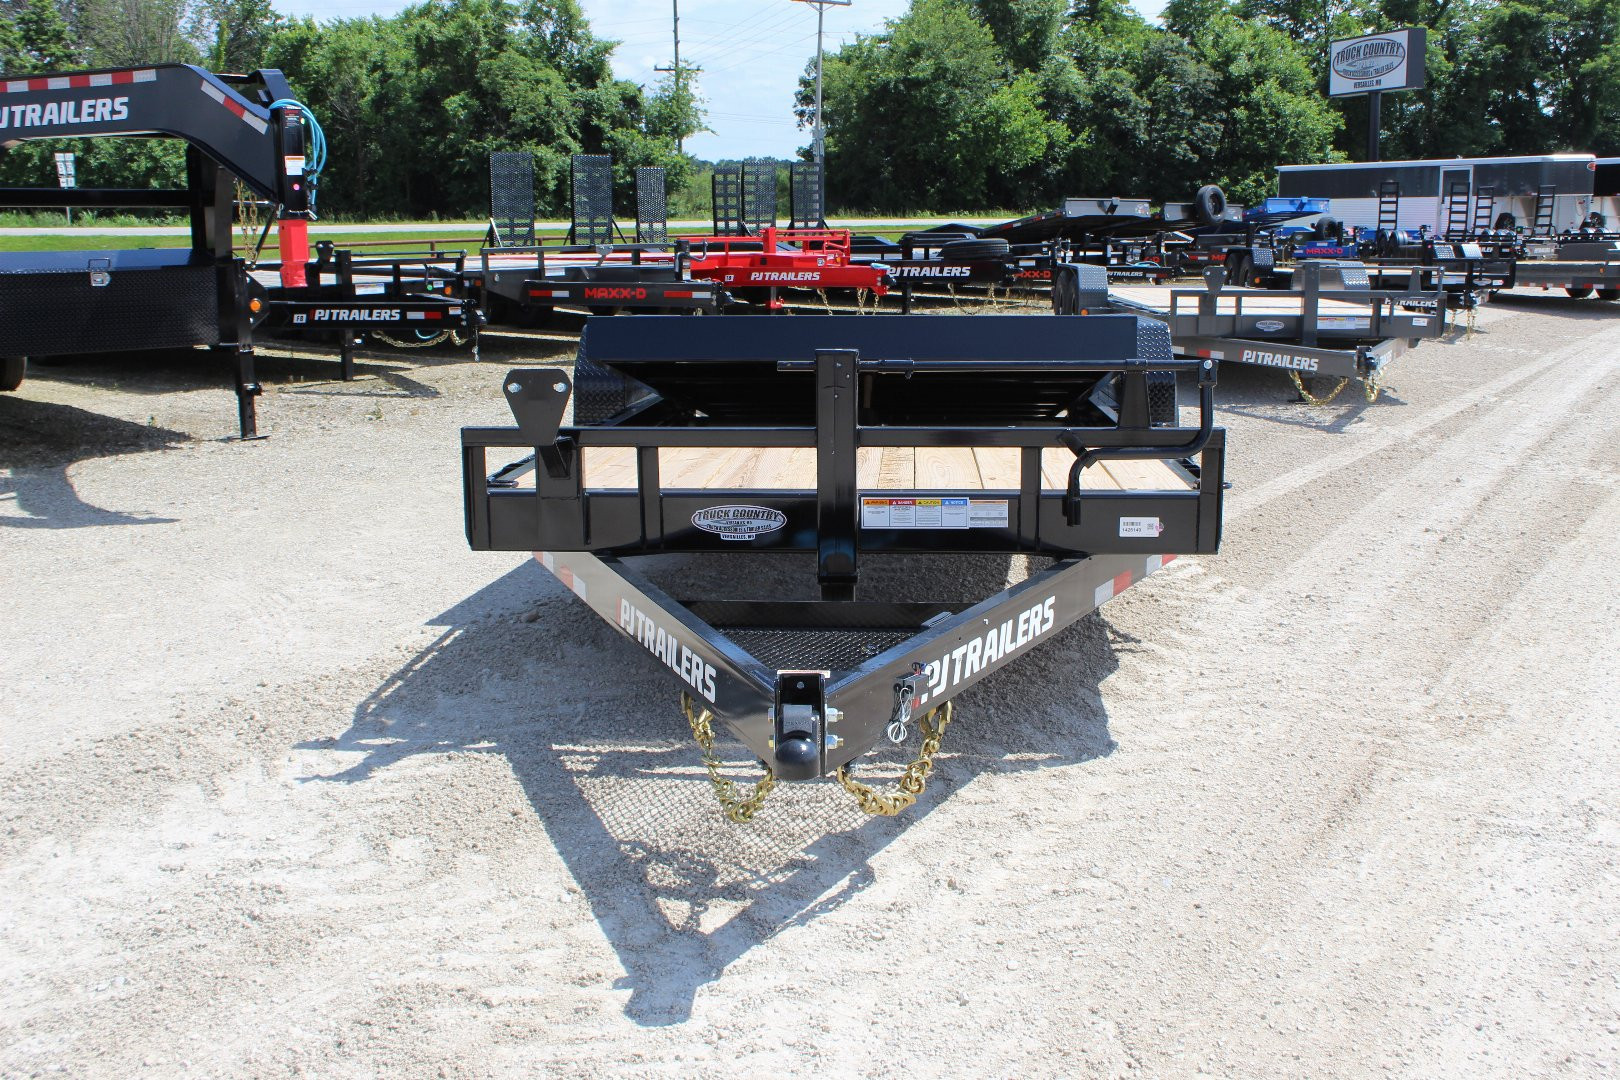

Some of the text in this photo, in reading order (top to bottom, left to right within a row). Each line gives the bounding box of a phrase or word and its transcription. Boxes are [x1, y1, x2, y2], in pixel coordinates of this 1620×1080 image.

[1336, 42, 1401, 66] TRUCK COUNTRY
[11, 97, 129, 128] TRAILERS
[763, 271, 820, 281] TRAILERS
[903, 267, 971, 277] TRAILERS
[584, 287, 647, 299] MAXX-D
[331, 309, 401, 321] TRAILERS
[1257, 351, 1320, 371] TRAILERS
[697, 508, 780, 521] TRUCK COUNTRY
[951, 595, 1056, 686] TRAILERS
[635, 609, 717, 704] TRAILERS
